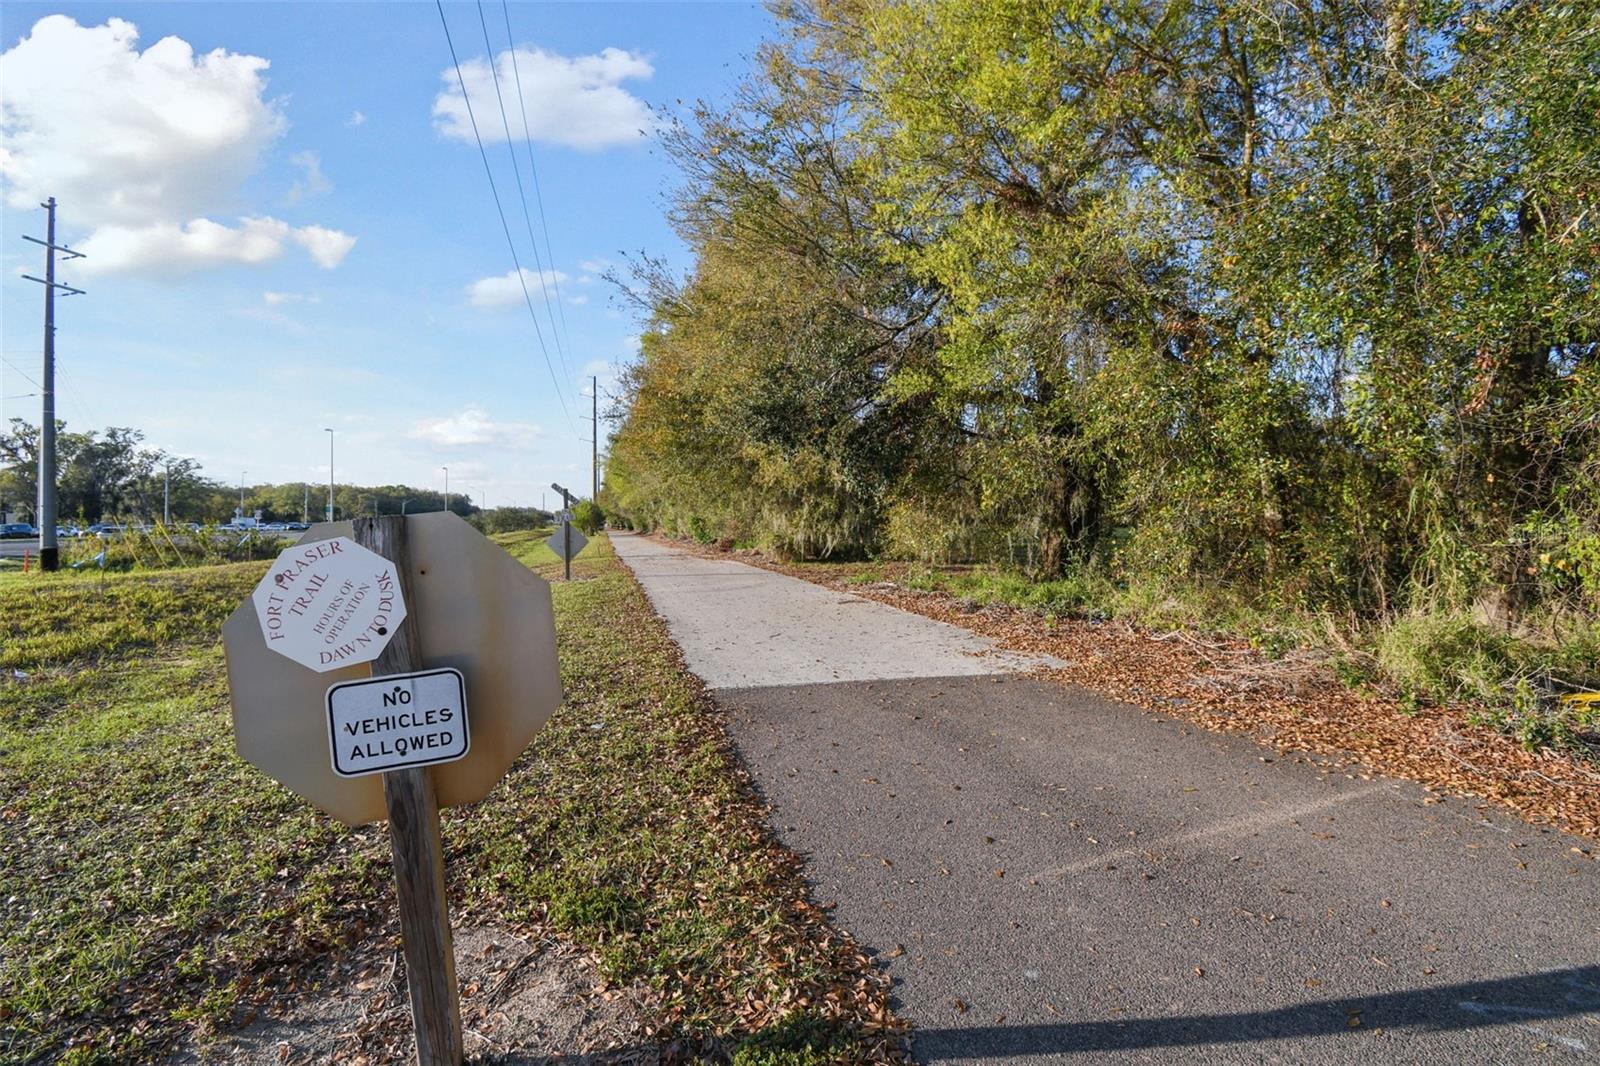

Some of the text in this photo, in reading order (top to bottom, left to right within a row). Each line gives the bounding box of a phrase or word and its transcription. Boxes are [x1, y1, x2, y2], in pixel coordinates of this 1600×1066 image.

[266, 541, 343, 641] FORT FRASER
[288, 574, 329, 616] TRAIL
[313, 578, 355, 635] HOURS OF
[325, 582, 371, 645] OPERATION
[319, 569, 395, 665] DAWN TO DUSK
[346, 708, 452, 736] VEHICLES
[383, 690, 411, 707] NO
[350, 731, 453, 760] ALLOWED
